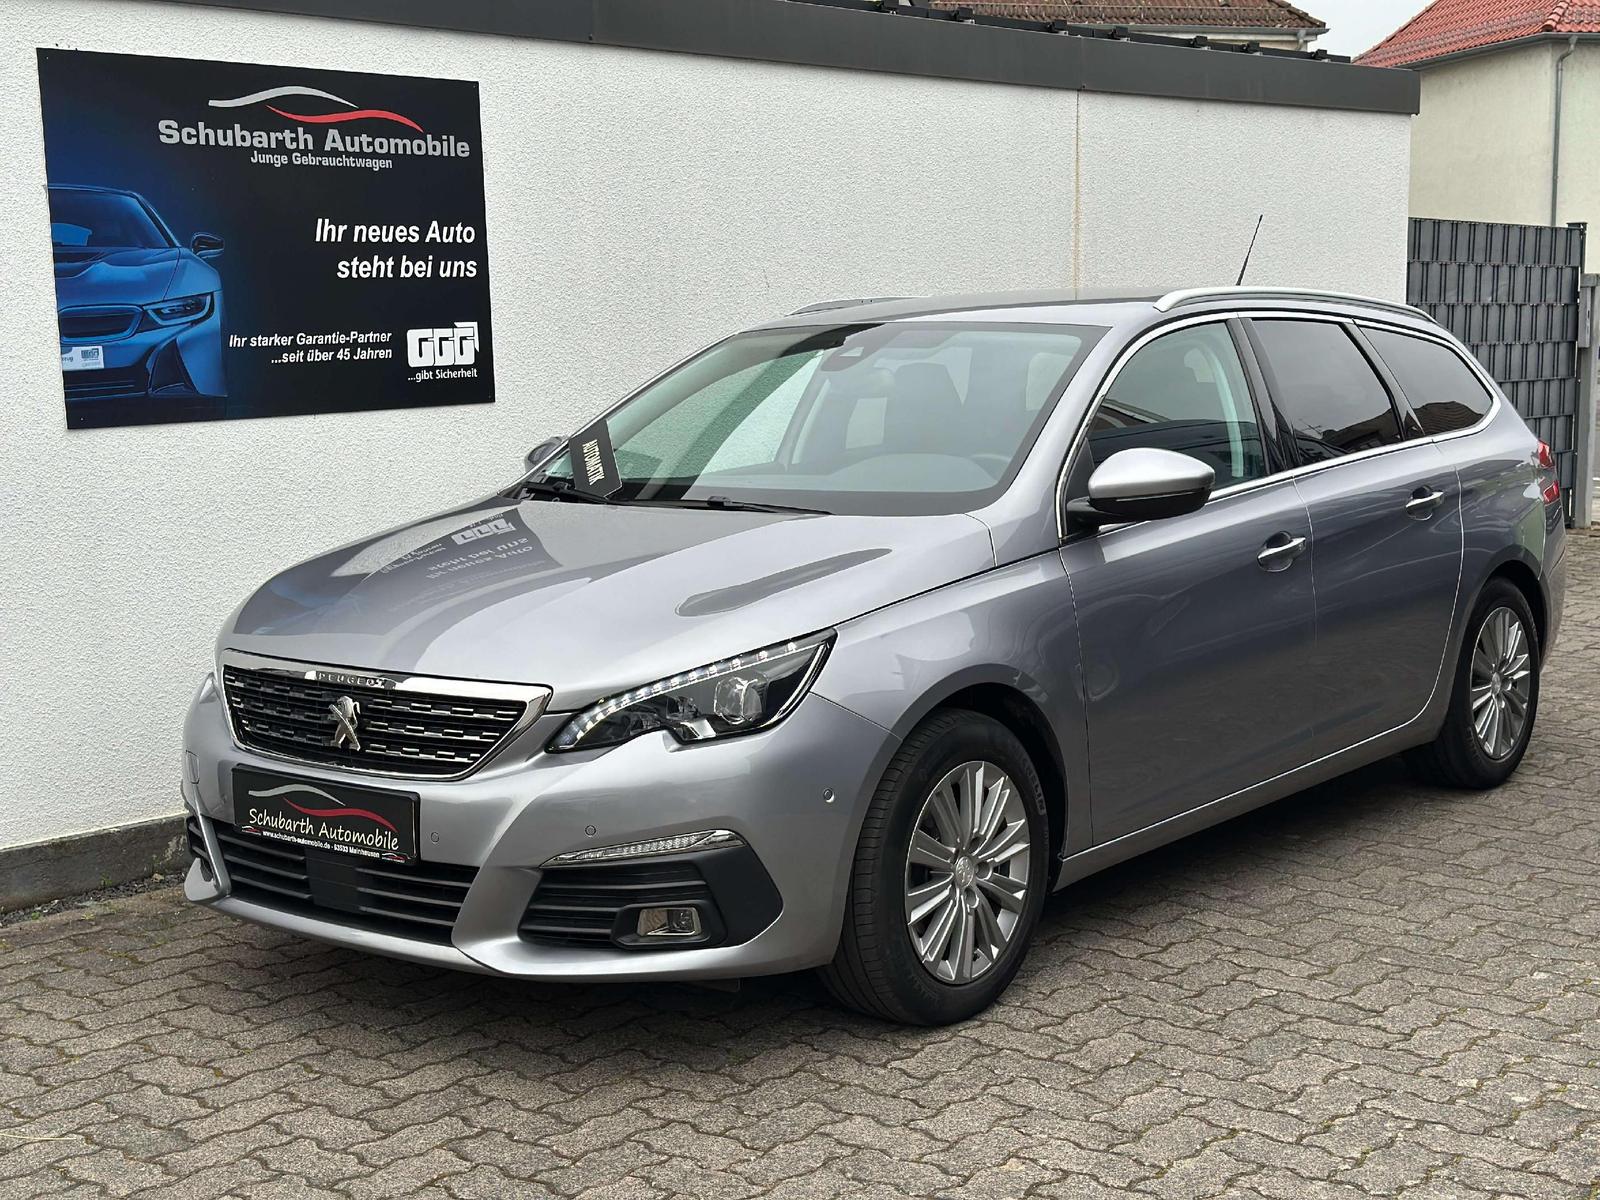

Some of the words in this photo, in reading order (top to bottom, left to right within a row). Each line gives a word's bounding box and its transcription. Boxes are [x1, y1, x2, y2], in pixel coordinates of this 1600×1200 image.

[157, 119, 314, 151] Schubarth
[324, 129, 470, 158] Automobile
[250, 150, 288, 168] Junge
[292, 152, 393, 171] Gebrauchtwagen
[315, 218, 347, 243] Ihr
[353, 224, 420, 243] neues
[425, 220, 476, 244] Auto
[337, 255, 395, 279] steht
[400, 255, 433, 279] bei
[439, 260, 478, 279] uns
[229, 334, 247, 348] Ihr
[250, 333, 293, 347] starker
[296, 330, 392, 346] Garantie-Partner
[271, 350, 304, 364] ...seit
[307, 349, 334, 363] über
[336, 350, 350, 361] 45
[353, 348, 393, 361] Jahren
[408, 370, 433, 383] ...gibt
[435, 368, 478, 380] Sicherheit
[582, 440, 605, 485] AUTOMATIK
[318, 673, 385, 688] PEUGEOT
[249, 808, 314, 835] Schubarth
[318, 822, 399, 850] Automobile
